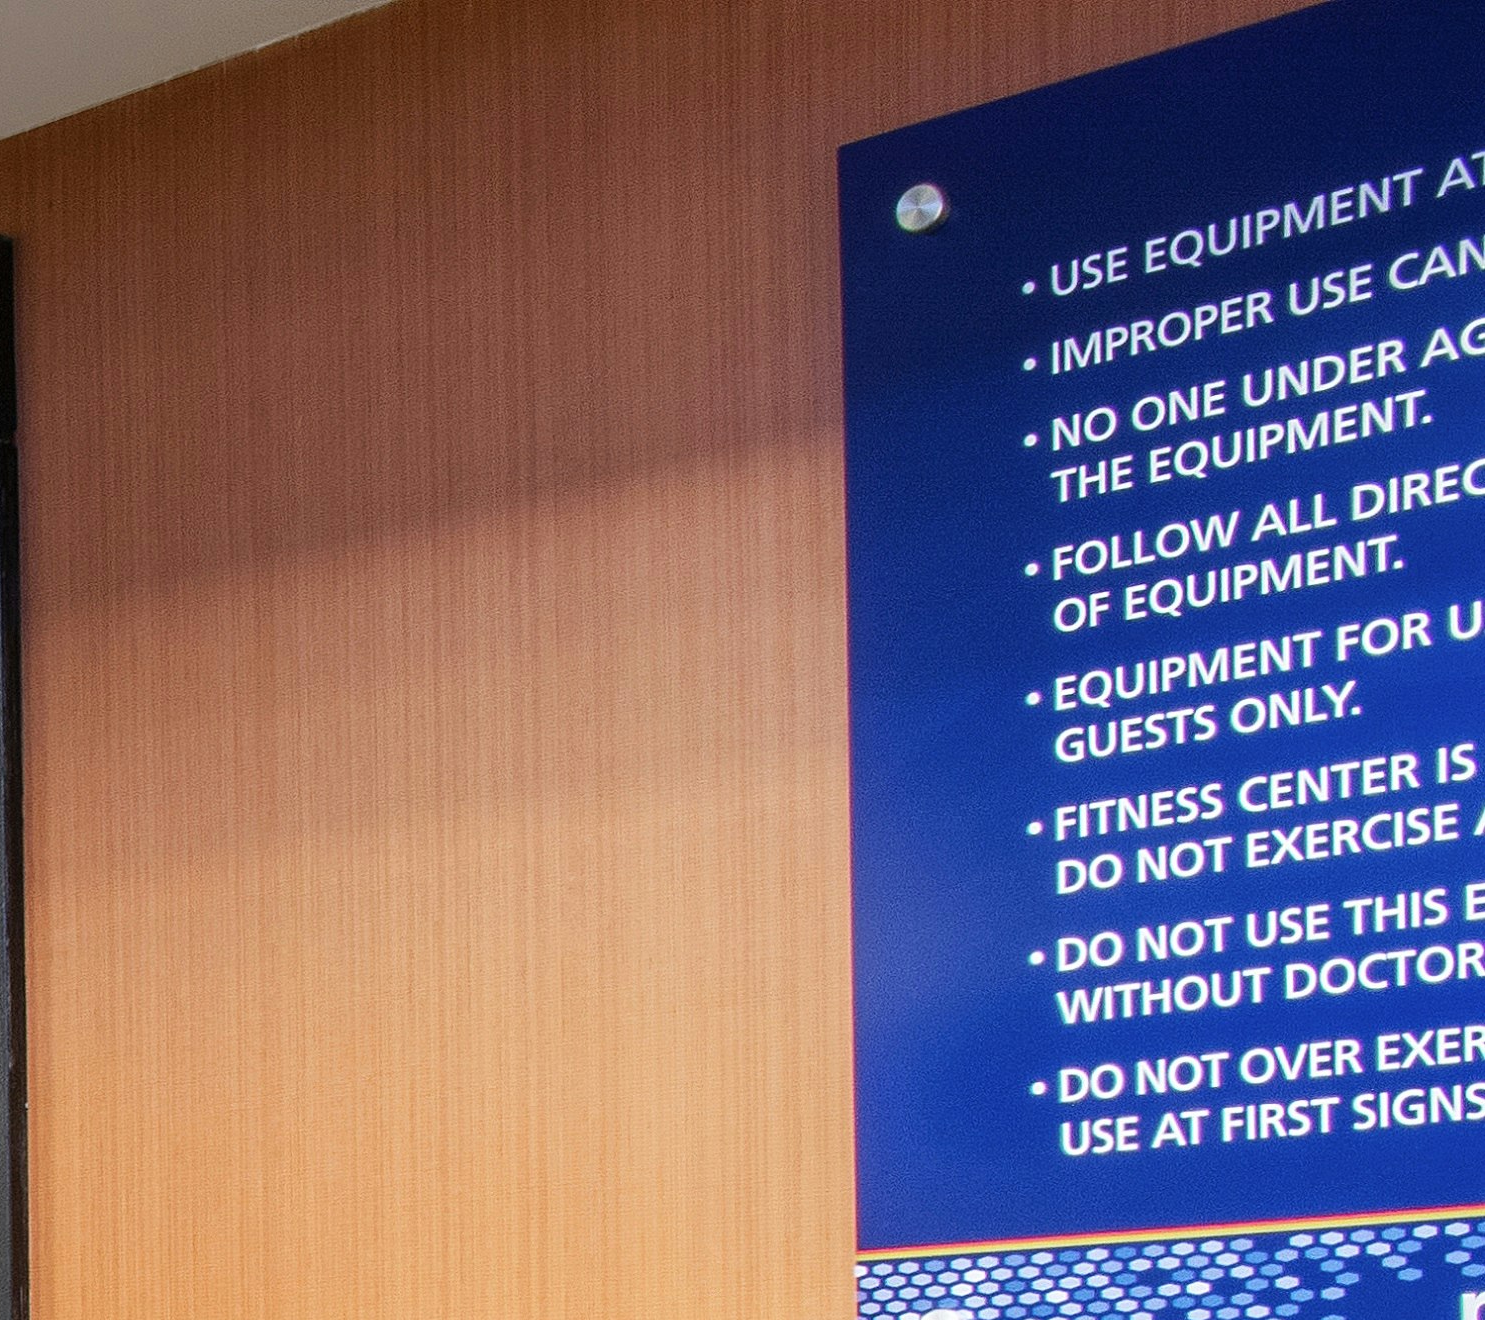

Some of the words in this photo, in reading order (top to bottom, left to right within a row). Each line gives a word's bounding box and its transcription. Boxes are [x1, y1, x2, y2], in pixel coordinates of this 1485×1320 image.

[1051, 247, 1128, 296] USE
[1145, 168, 1423, 273] EQUIPMENT
[1052, 292, 1274, 374] IMPROPER
[1289, 264, 1372, 315] USE
[1053, 407, 1117, 451] NO
[1132, 380, 1225, 431] ONE
[1243, 340, 1406, 407] UNDER
[1050, 455, 1133, 502] THE
[1150, 386, 1432, 483] EQUIPMENT.
[1054, 511, 1239, 580] FOLLOW
[1251, 494, 1337, 541] ALL
[1054, 591, 1110, 632] OF
[1125, 531, 1403, 620] EQUIPMENT.
[1055, 631, 1322, 711] EQUIPMENT
[1337, 612, 1432, 661] FOR
[1055, 705, 1217, 762] GUESTS
[1230, 680, 1361, 733] ONLY.
[1056, 783, 1223, 841] FITNESS
[1238, 753, 1420, 812] CENTER
[1437, 743, 1476, 783] IS
[1057, 854, 1123, 894] DO
[1137, 836, 1233, 883] NOT
[1247, 803, 1459, 868] EXERCISE
[1057, 931, 1123, 972] DO
[1137, 916, 1233, 962] NOT
[1247, 904, 1330, 947] USE
[1343, 888, 1448, 935] THIS
[1056, 967, 1271, 1024] WITHOUT
[1285, 944, 1485, 999] DOCTOR
[1059, 1064, 1124, 1103] DO
[1136, 1052, 1229, 1095] NOT
[1240, 1039, 1363, 1084] OVER
[1061, 1116, 1139, 1156] USE
[1151, 1109, 1210, 1148] AT
[1222, 1097, 1340, 1142] FIRST
[1353, 1082, 1485, 1131] SIGNS
